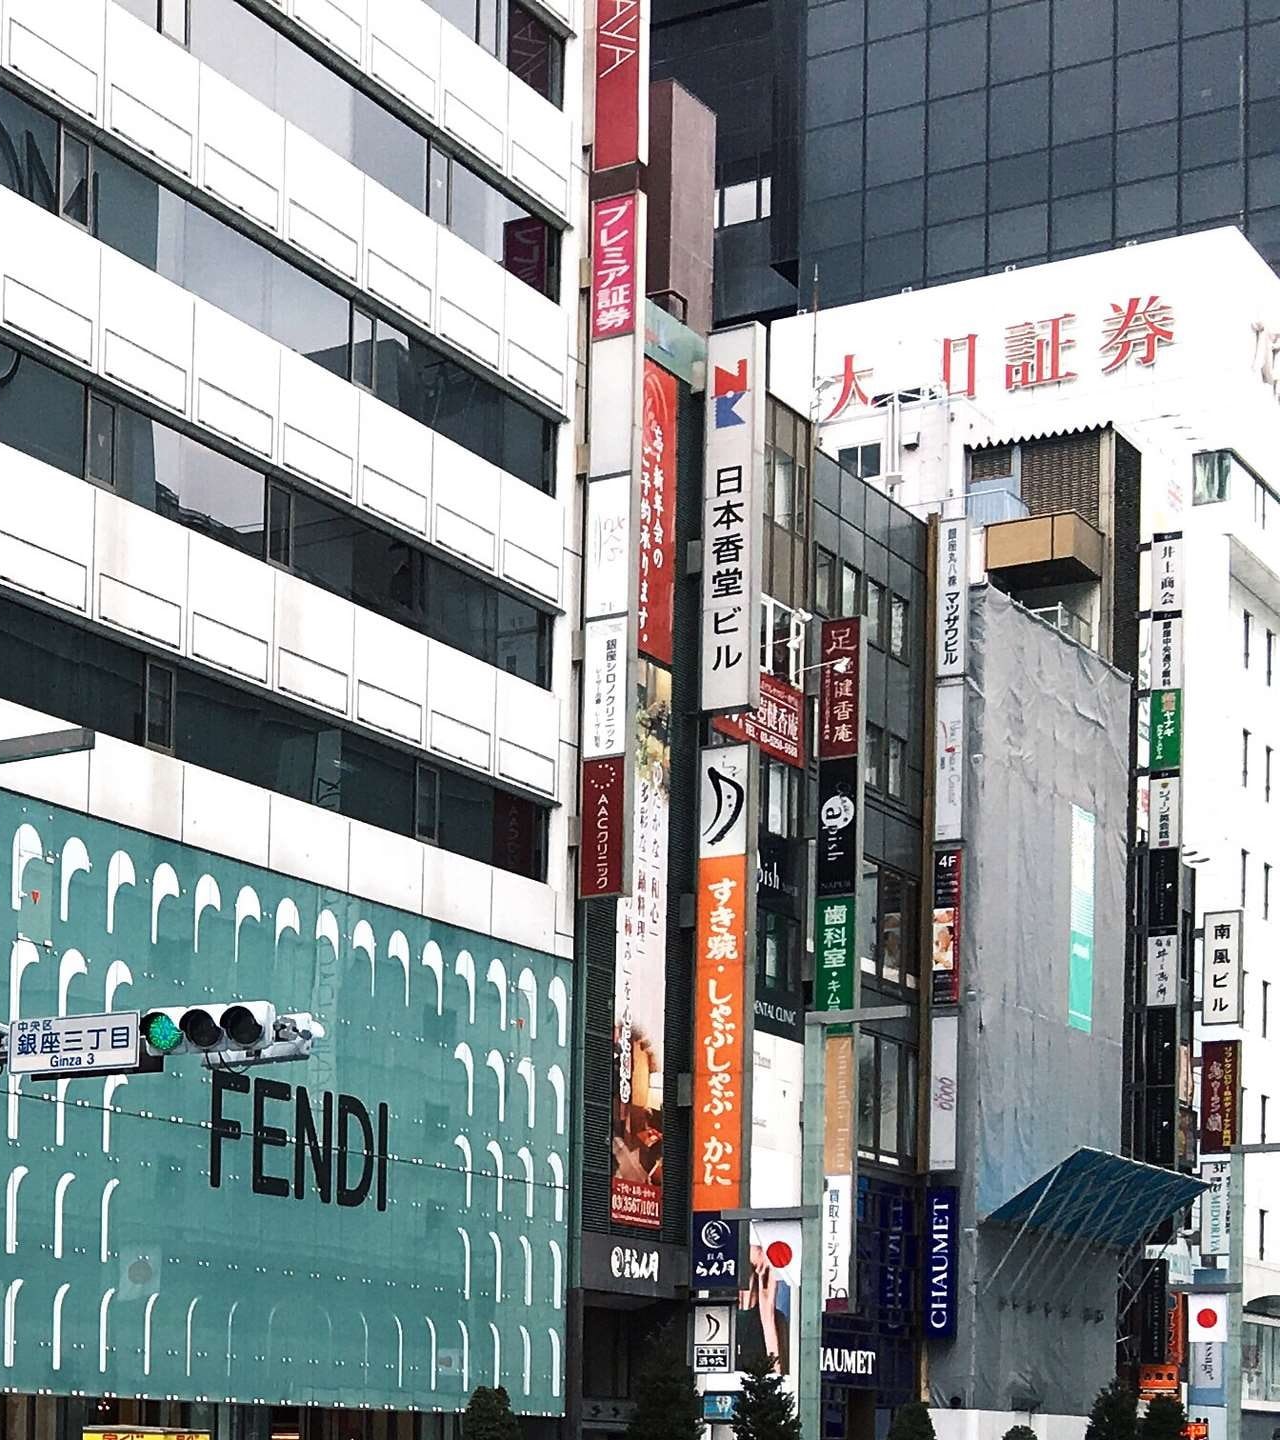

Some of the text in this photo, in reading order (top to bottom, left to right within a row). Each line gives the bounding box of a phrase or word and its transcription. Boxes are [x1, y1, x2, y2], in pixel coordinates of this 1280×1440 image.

[595, 199, 633, 331] プレミア証券
[711, 465, 745, 672] 日本香堂ビル
[943, 591, 961, 665] マツザワビル
[596, 793, 609, 889] AACクリニック
[939, 855, 958, 868] 4F
[757, 861, 780, 891] pish
[1212, 924, 1232, 1011] 南風ビル
[17, 1019, 53, 1032] 中央区
[754, 1000, 775, 1019] ENTAL
[17, 1026, 130, 1055] 銀座三丁目
[703, 878, 738, 1186] すき焼・しゃぶしゃぶ・かに
[50, 1053, 95, 1068] Ginza 3
[210, 1070, 388, 1211] FENDI
[1212, 1163, 1227, 1174] 3F
[1209, 1194, 1221, 1253] MIDORIYA
[695, 1259, 736, 1277] らん月
[930, 1198, 949, 1329] CHAUMET
[820, 1347, 876, 1375] AUMET
